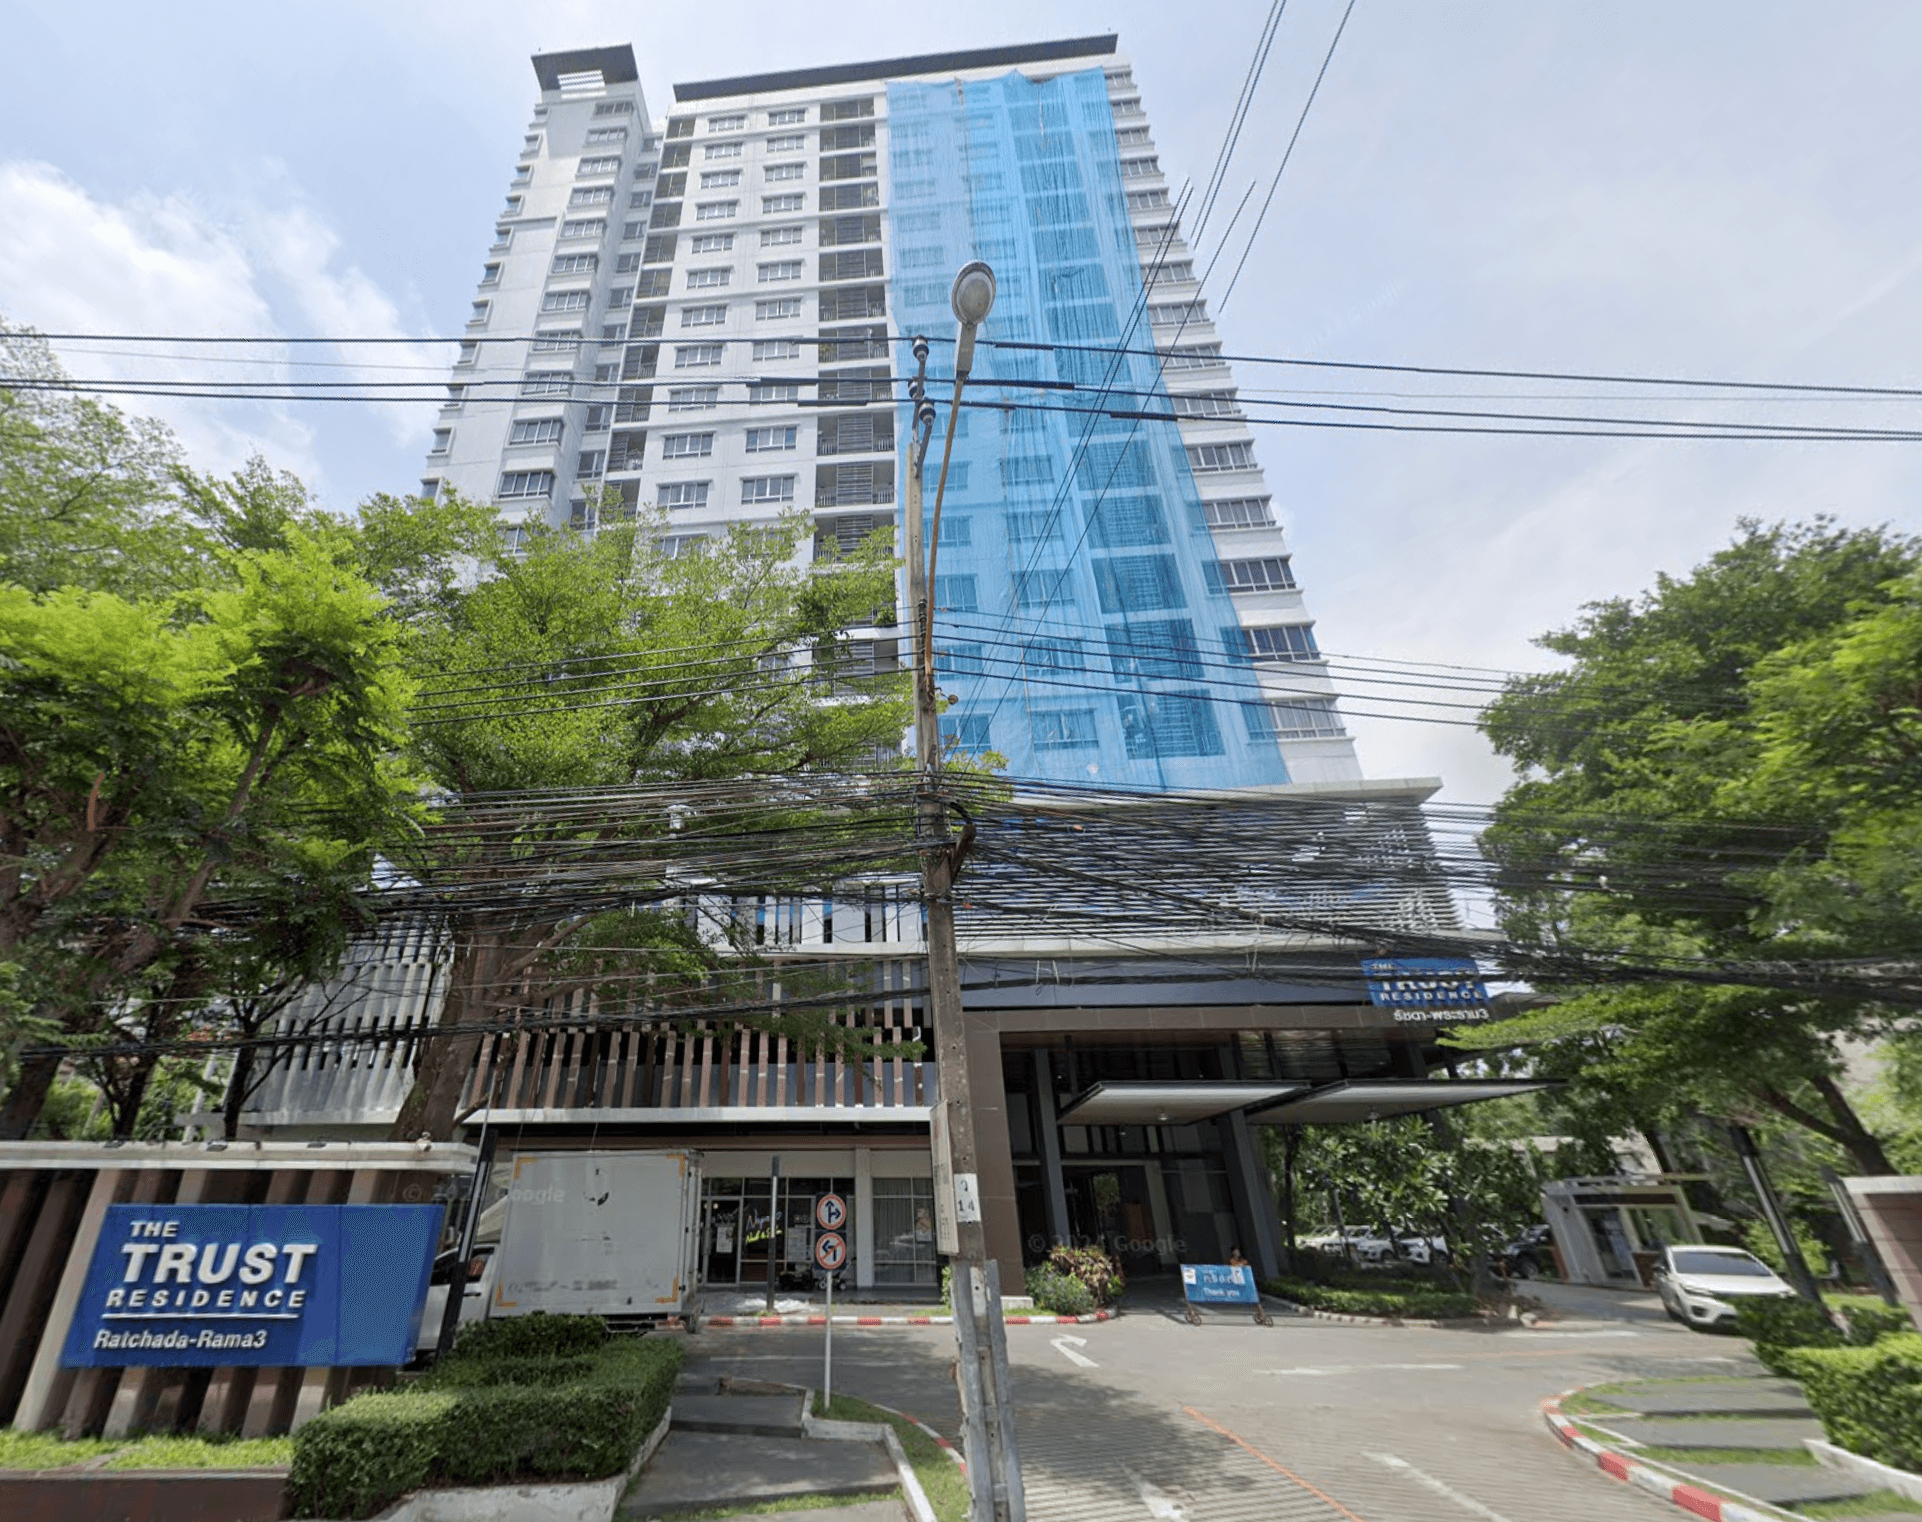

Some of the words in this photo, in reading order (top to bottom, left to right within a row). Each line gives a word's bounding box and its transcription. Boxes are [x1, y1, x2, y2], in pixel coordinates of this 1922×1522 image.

[1380, 991, 1484, 1001] RESIDENCE
[130, 1220, 179, 1237] THE
[121, 1243, 318, 1284] TRUST
[105, 1289, 306, 1308] RESIDENCE
[93, 1328, 268, 1349] Ratchada-Rama3
